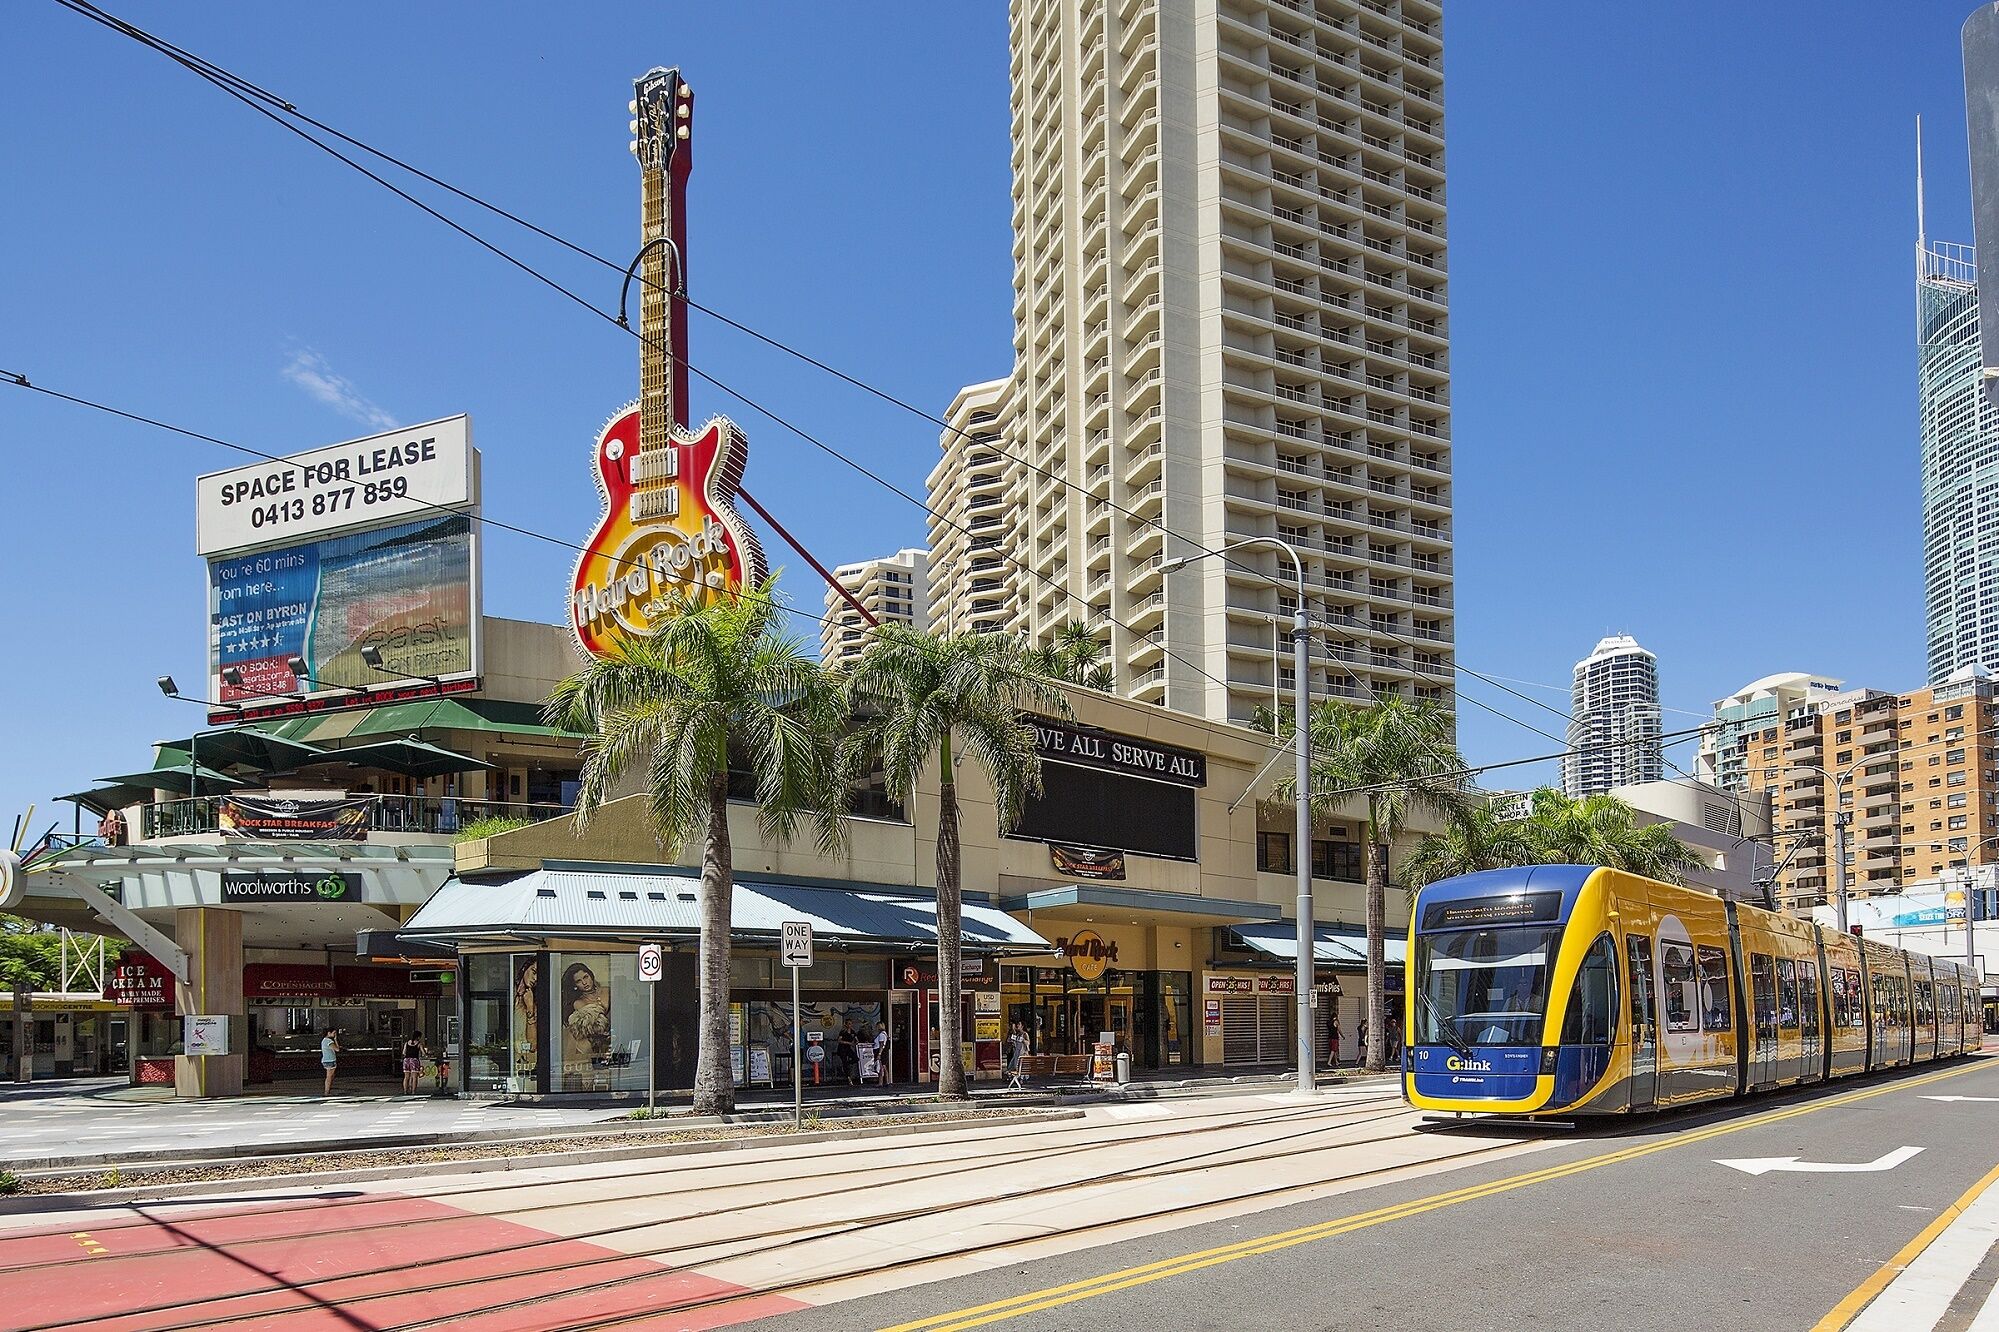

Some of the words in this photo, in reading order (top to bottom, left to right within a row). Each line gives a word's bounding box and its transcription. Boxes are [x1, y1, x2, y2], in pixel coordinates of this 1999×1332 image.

[643, 76, 667, 97] Gibson
[221, 469, 296, 506] SPACE
[304, 458, 350, 488] FOR
[358, 437, 436, 477] LEASE
[252, 500, 305, 529] 0413
[312, 486, 355, 516] 877
[364, 476, 408, 506] 859
[256, 558, 271, 575] 60
[275, 552, 305, 570] mins
[573, 556, 648, 628] Hard
[650, 514, 729, 585] Rock
[220, 587, 242, 601] rom
[247, 609, 263, 624] ON
[267, 602, 307, 621] BYRON
[1028, 724, 1066, 751] OVE
[1070, 735, 1105, 759] ALL
[1112, 742, 1166, 771] SERVE
[1168, 756, 1199, 778] ALL
[240, 819, 262, 827] ROCK
[263, 819, 283, 827] STAR
[284, 819, 338, 829] BREAKFAST
[1947, 910, 1965, 919] DRY
[786, 926, 807, 938] ONE
[785, 939, 809, 950] WAY
[1057, 937, 1088, 957] Hard
[1090, 937, 1119, 963] Rock
[643, 956, 659, 970] 50
[120, 966, 145, 977] ICE
[920, 972, 937, 981] Red
[112, 978, 163, 989] CREAM
[263, 980, 334, 989] COPENHAGEN
[1211, 980, 1226, 989] OPEN
[1228, 980, 1236, 989] 25
[1237, 980, 1250, 990] HRS!
[1258, 980, 1268, 989] PEN
[1270, 980, 1278, 989] 25
[1279, 980, 1292, 989] HRS!
[1328, 981, 1340, 993] Pies
[1419, 1050, 1429, 1060] 10
